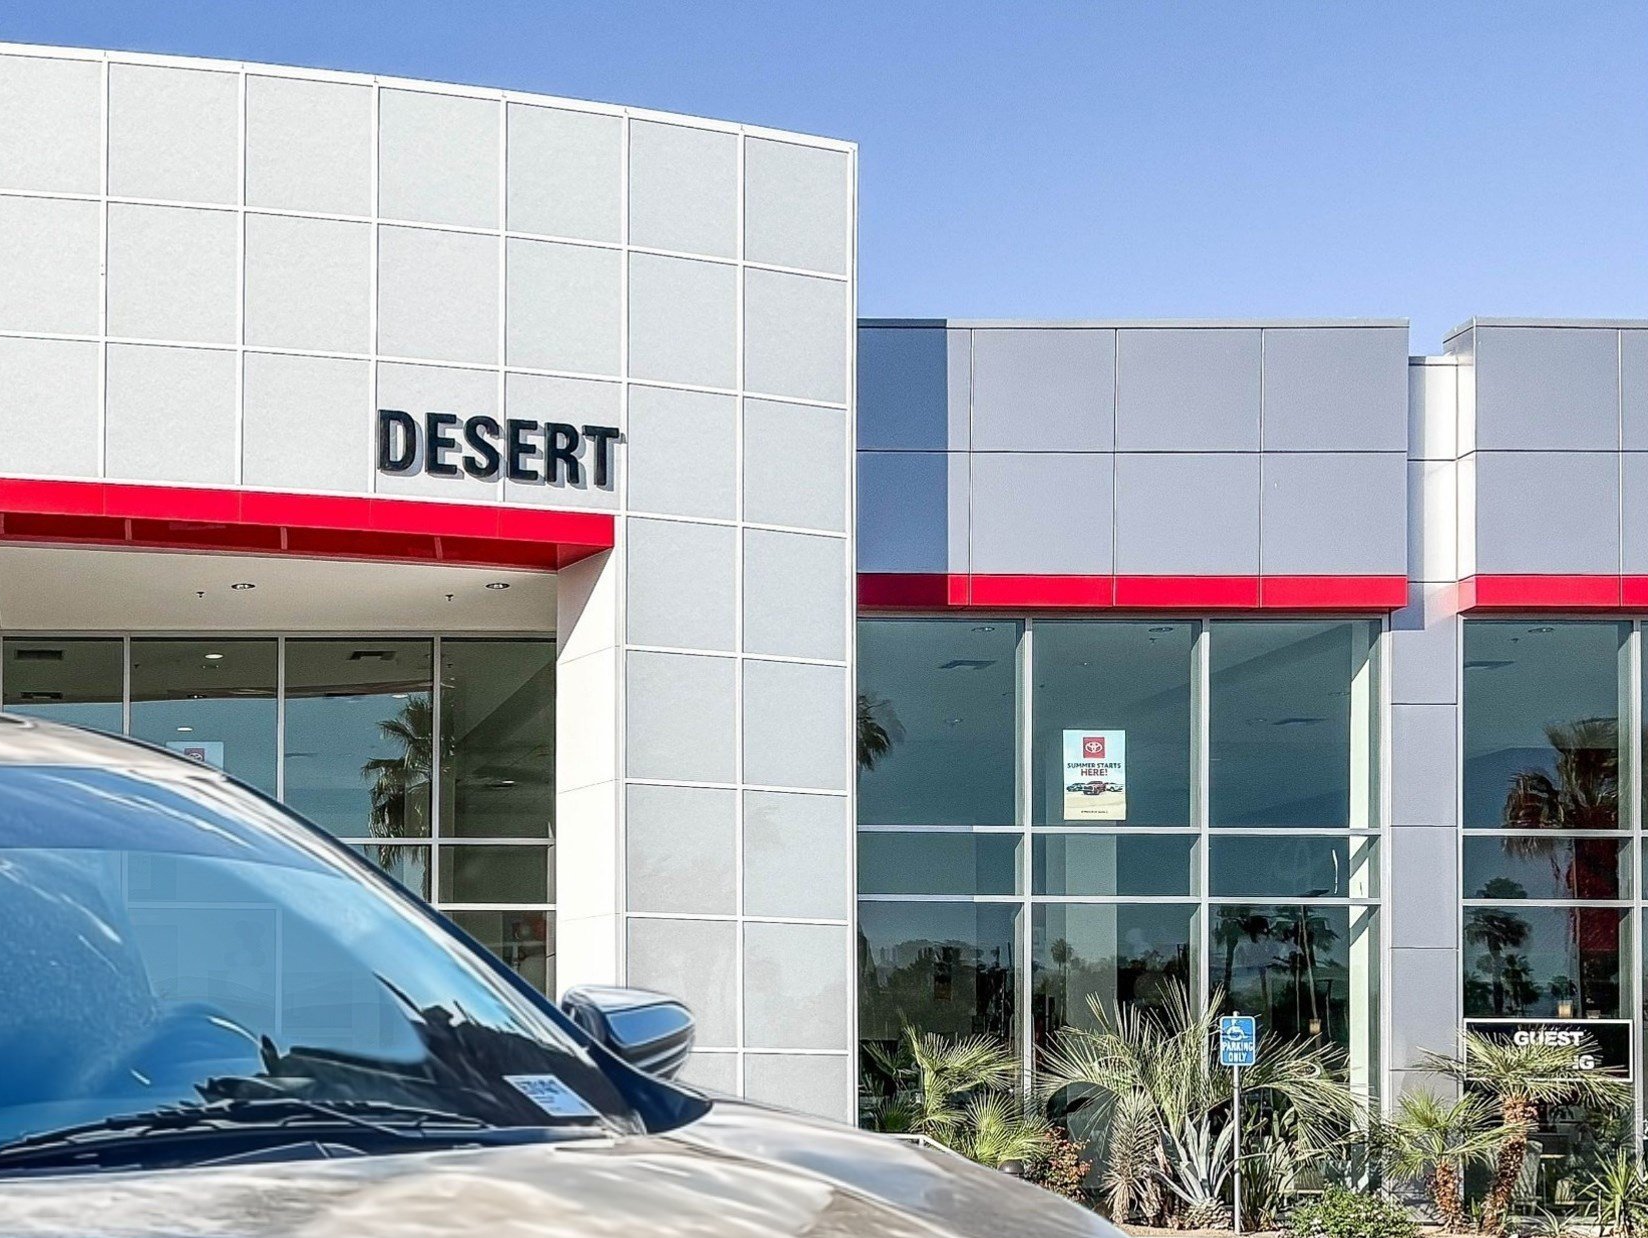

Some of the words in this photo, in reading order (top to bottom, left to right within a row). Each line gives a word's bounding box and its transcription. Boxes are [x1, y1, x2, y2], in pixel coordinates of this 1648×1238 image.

[377, 409, 620, 487] DESERT
[1080, 768, 1108, 777] HERE!
[1222, 1041, 1253, 1052] PARKING
[1228, 1052, 1248, 1063] ONLY
